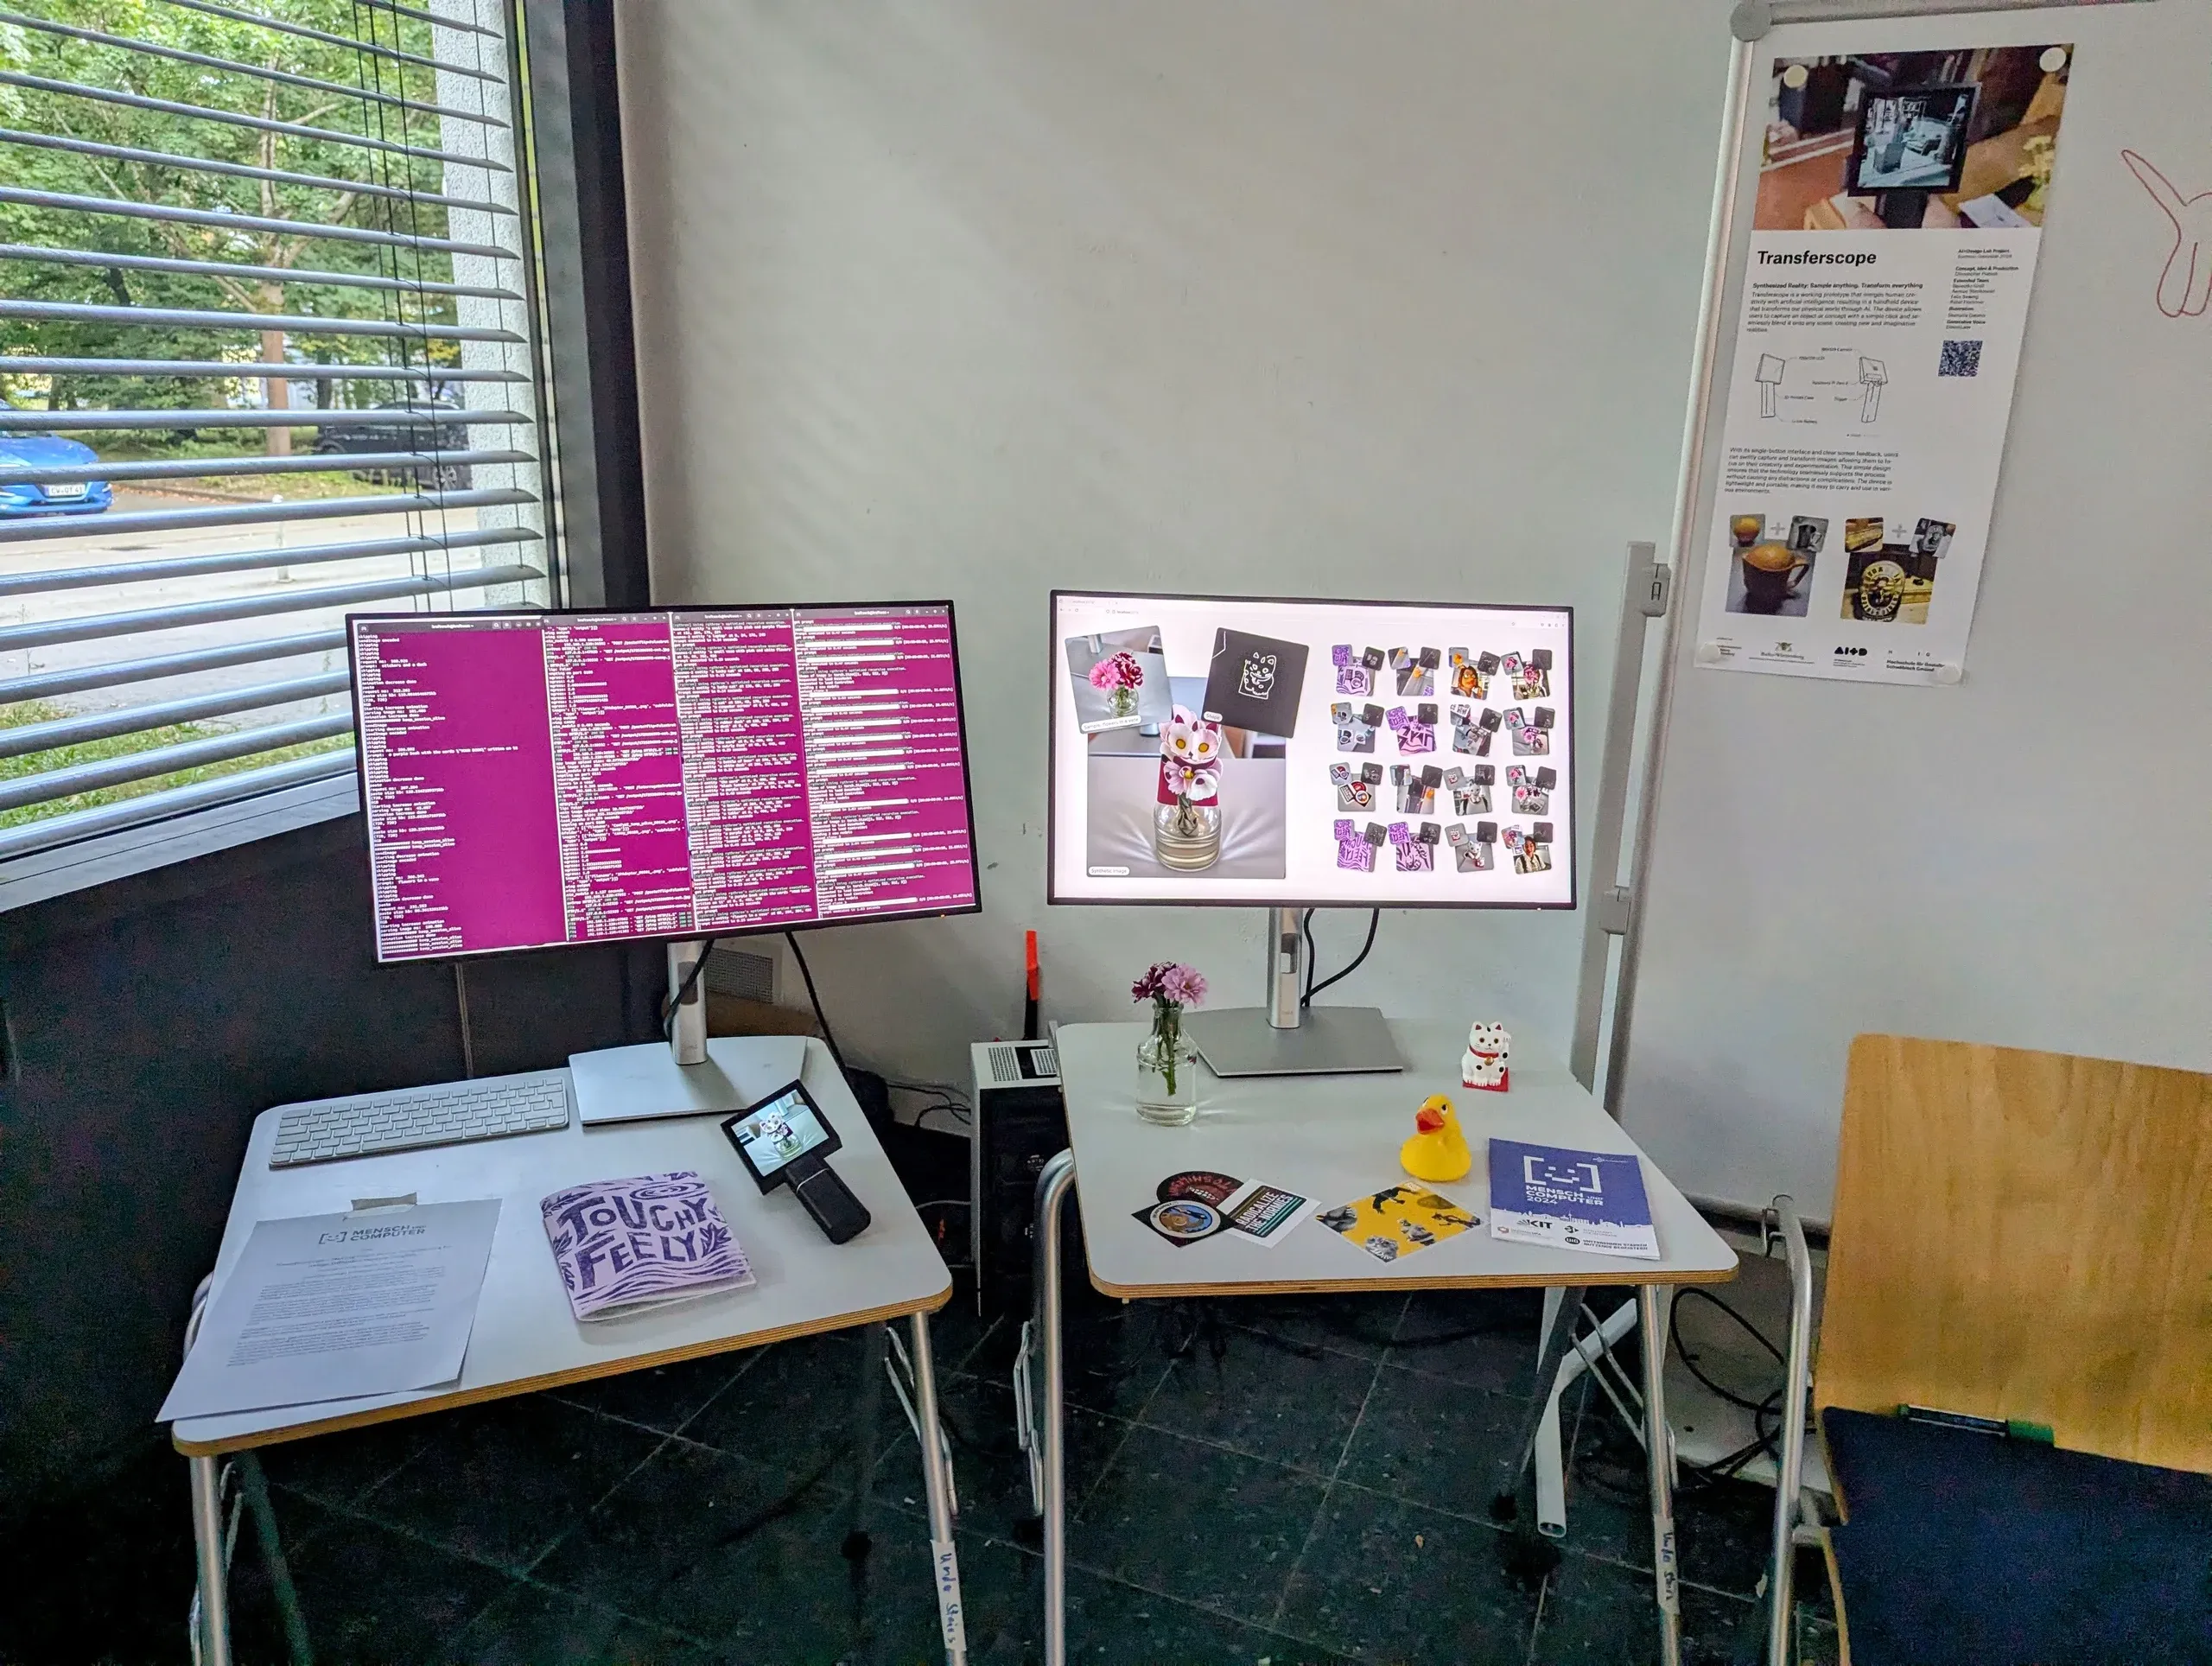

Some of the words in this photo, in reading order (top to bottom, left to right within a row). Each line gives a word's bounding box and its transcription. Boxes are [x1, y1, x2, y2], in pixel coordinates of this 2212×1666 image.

[1757, 250, 1877, 266] Transferscope
[1526, 1185, 1584, 1198] MENSCH
[1526, 1191, 1604, 1205] COMPUTER
[1527, 1196, 1558, 1205] 2024
[1235, 1191, 1281, 1225] RADICALIZE
[1245, 1217, 1264, 1232] THE
[1262, 1194, 1294, 1225] NORMIES
[556, 1195, 709, 1246] TOUCHY
[1528, 1219, 1552, 1230] KIT
[350, 1229, 425, 1242] COMPUTER
[352, 1224, 410, 1236] MENSCH
[575, 1230, 699, 1290] FEELY
